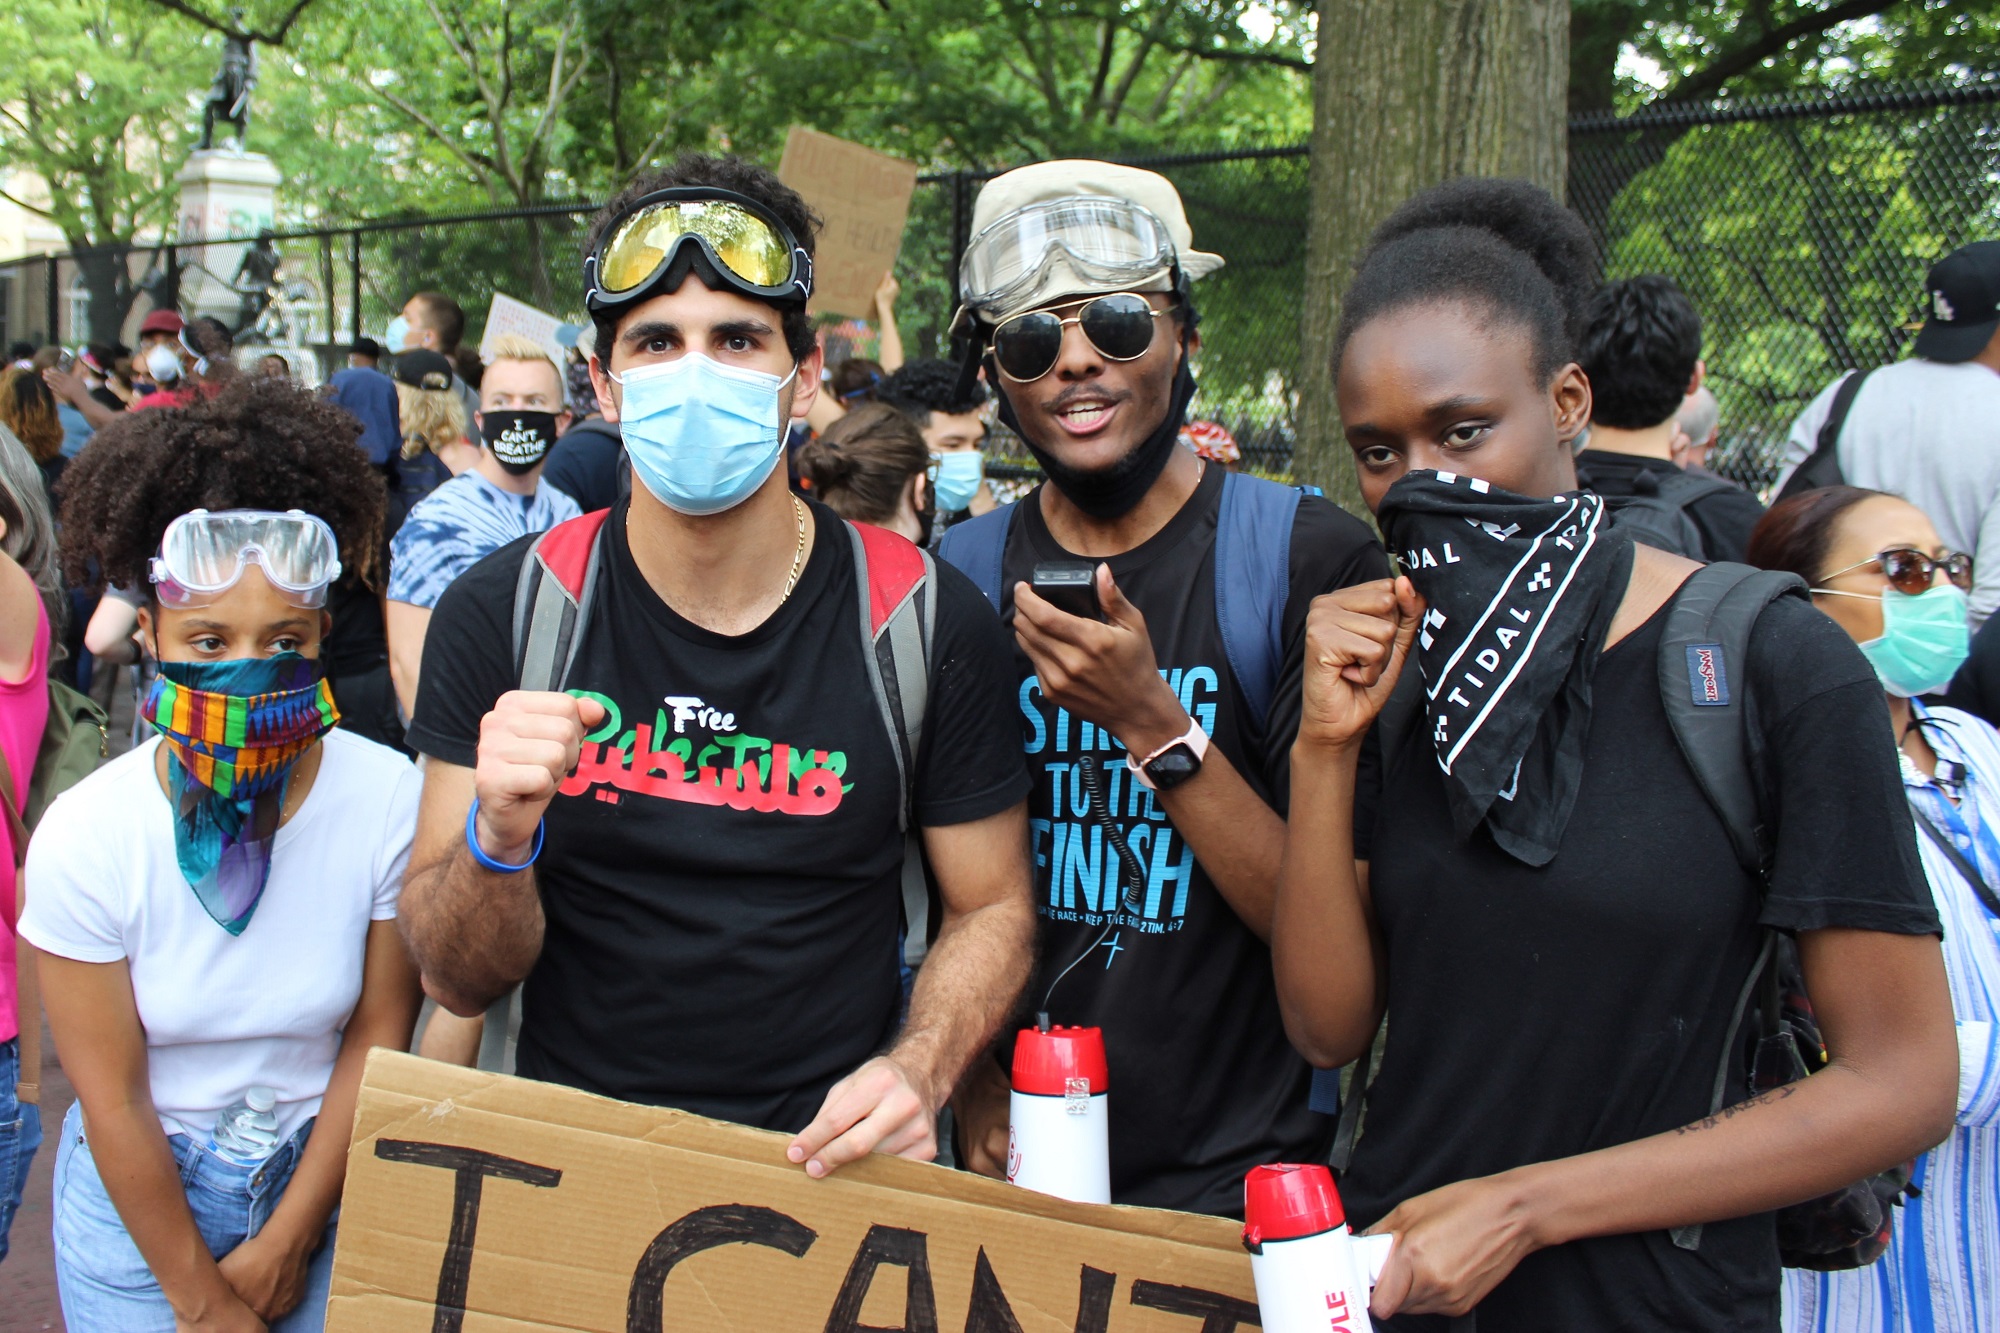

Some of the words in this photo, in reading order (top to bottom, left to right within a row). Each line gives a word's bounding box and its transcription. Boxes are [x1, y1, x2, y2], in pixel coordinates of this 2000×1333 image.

[501, 429, 538, 444] CAN'T
[513, 419, 523, 431] I
[493, 439, 546, 455] BREATHE
[1447, 606, 1531, 708] TIDAL
[664, 696, 737, 734] Free
[1045, 762, 1091, 818] TO
[1029, 818, 1196, 920] FINISH
[1057, 911, 1077, 922] RACE
[1140, 921, 1146, 933] 2
